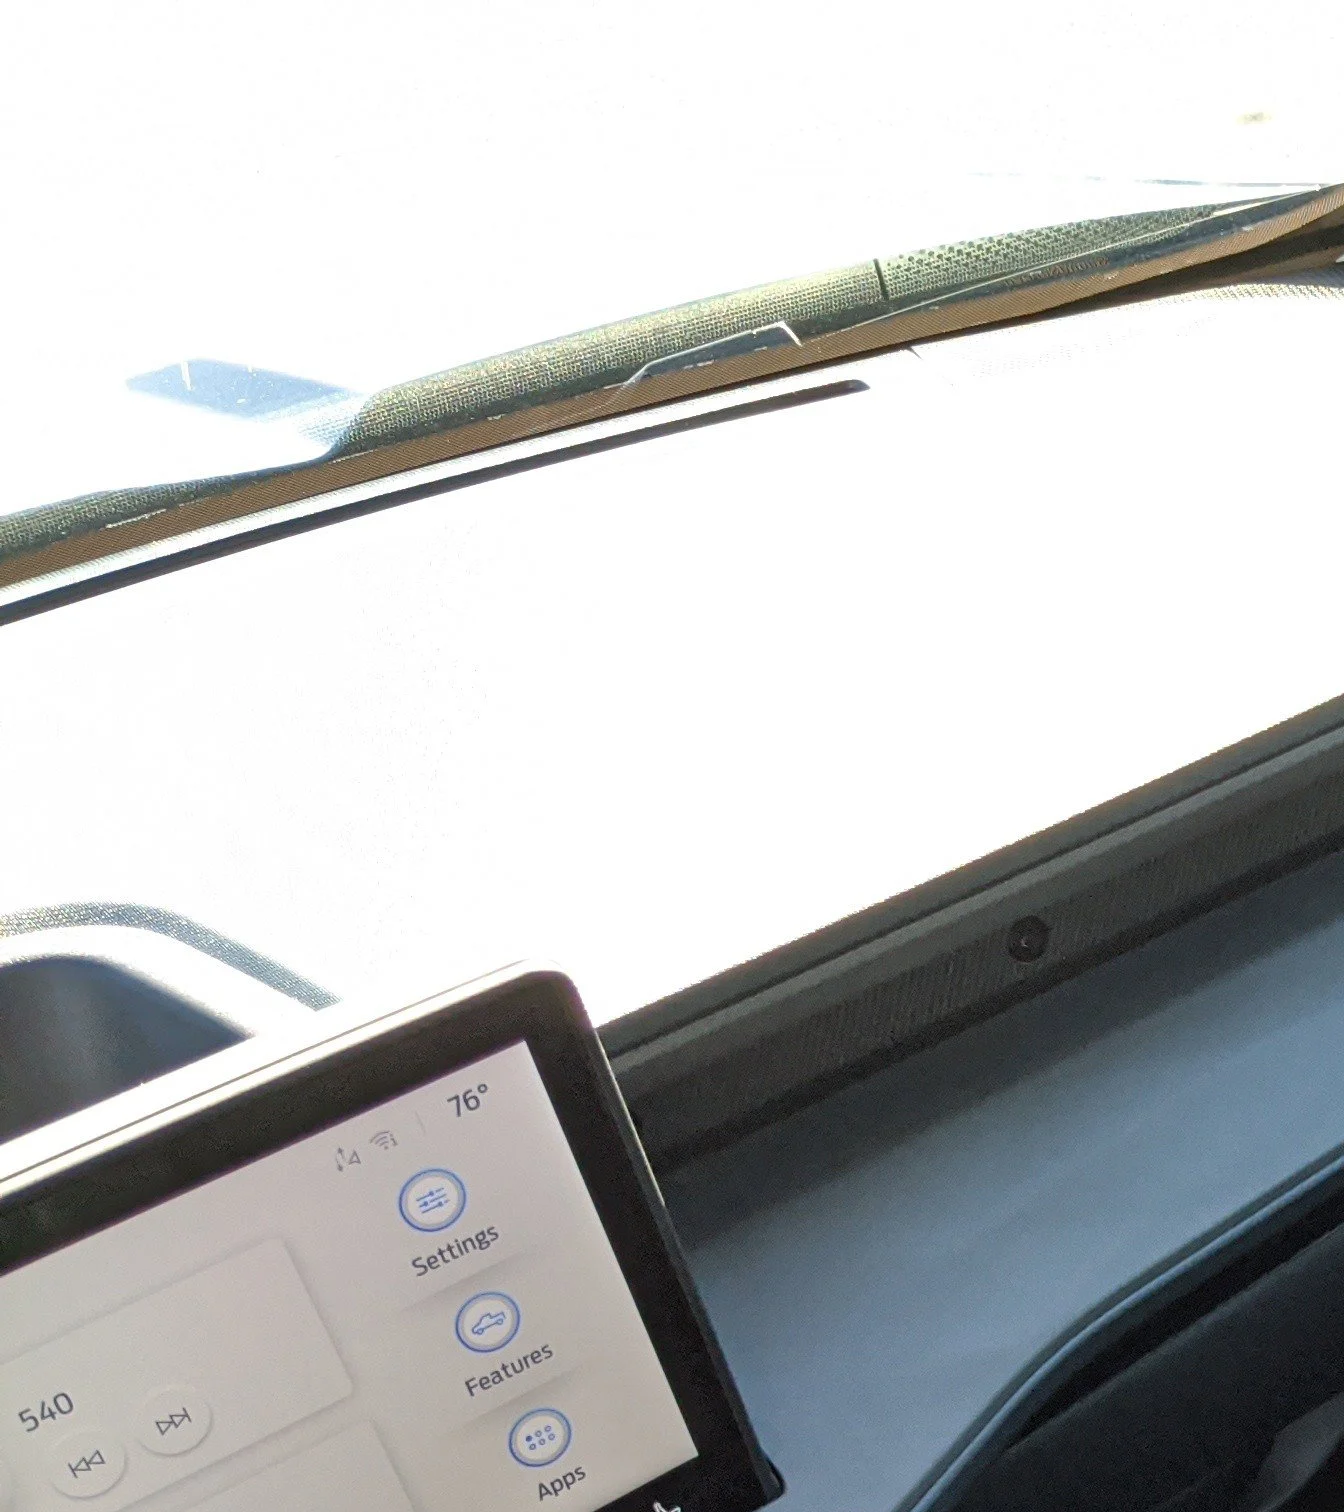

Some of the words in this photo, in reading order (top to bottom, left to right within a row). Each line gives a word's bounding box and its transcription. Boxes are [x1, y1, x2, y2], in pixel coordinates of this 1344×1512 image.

[446, 1082, 490, 1119] 76°
[410, 1223, 500, 1278] Settings
[463, 1341, 555, 1398] Features
[17, 1390, 76, 1433] 540
[536, 1462, 588, 1502] Apps
